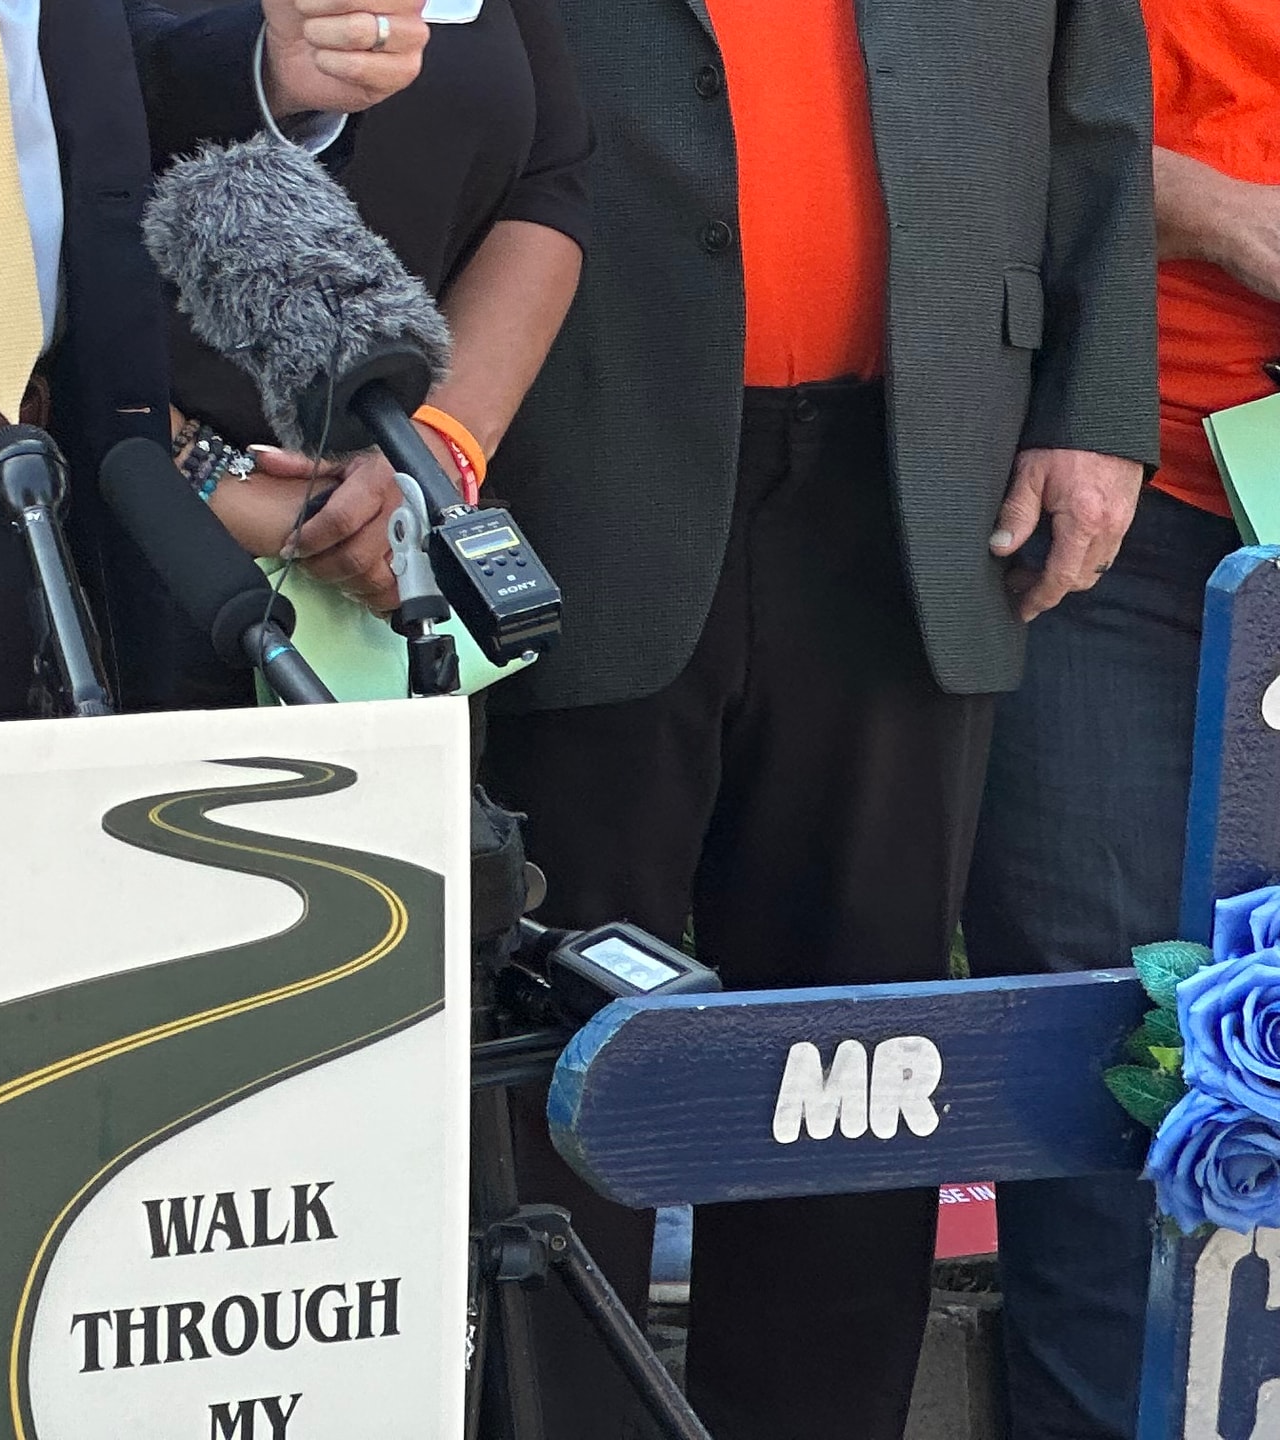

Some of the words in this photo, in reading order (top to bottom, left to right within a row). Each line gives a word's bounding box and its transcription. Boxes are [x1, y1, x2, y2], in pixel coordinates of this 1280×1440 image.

[497, 579, 538, 597] SONY
[773, 1035, 942, 1144] MR
[142, 1180, 339, 1260] WALK
[939, 1187, 971, 1205] SE
[70, 1277, 402, 1374] THROUGH
[208, 1392, 304, 1440] MY
